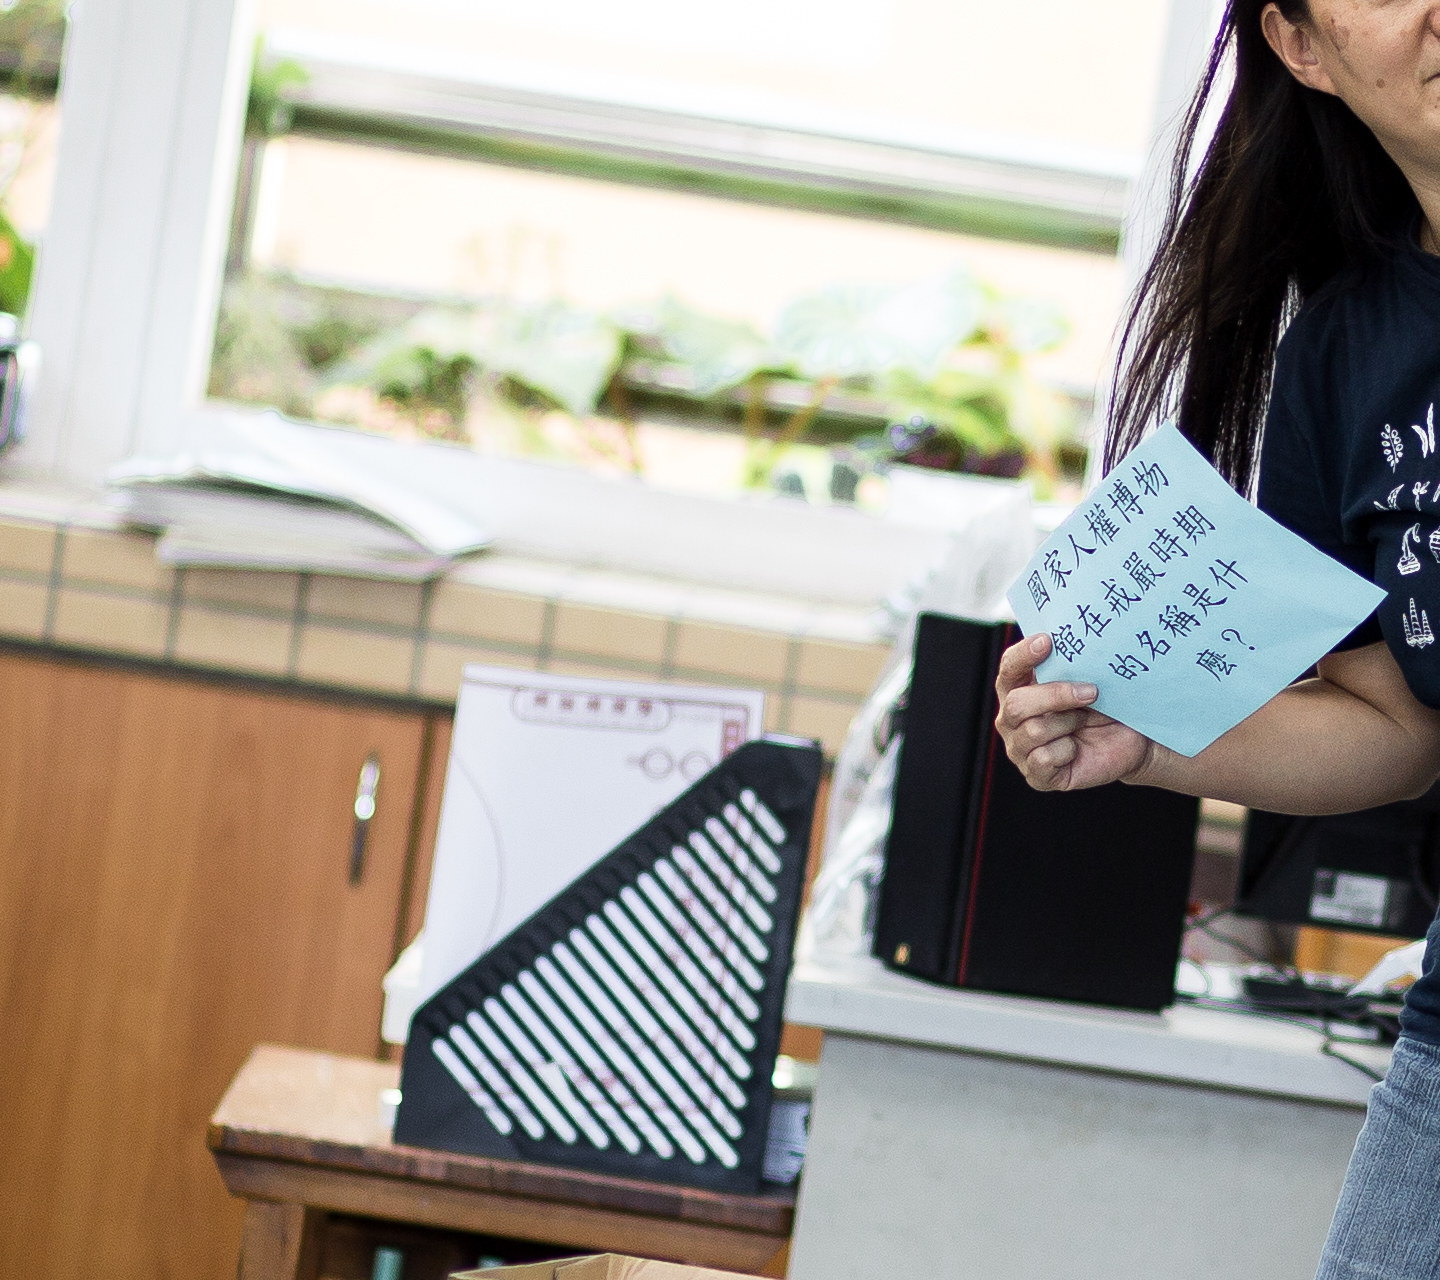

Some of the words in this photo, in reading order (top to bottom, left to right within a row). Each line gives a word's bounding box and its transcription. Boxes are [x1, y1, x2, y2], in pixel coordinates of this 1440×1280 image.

[1025, 460, 1171, 612] 國家人權博物
[1049, 504, 1217, 664] 館在戒嚴時期
[1107, 557, 1249, 682] 的名稱是什
[1194, 626, 1257, 683] 麼?
